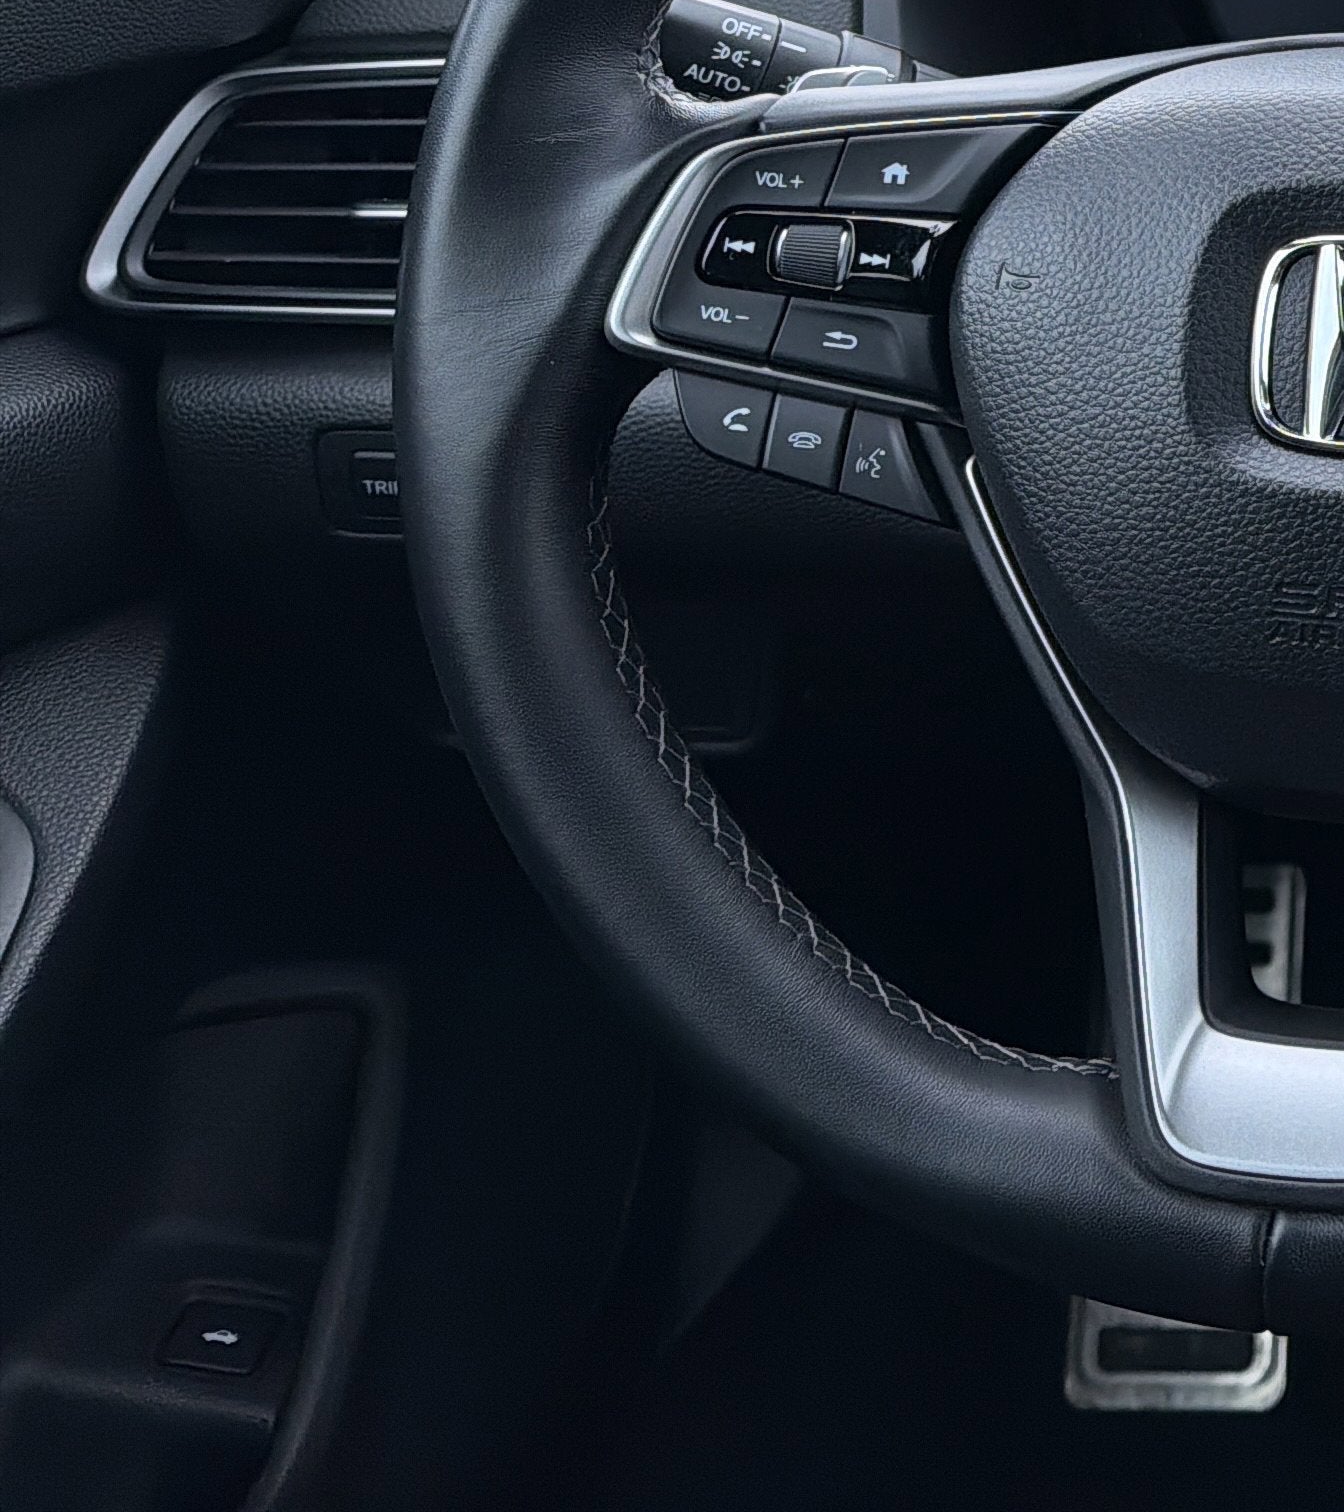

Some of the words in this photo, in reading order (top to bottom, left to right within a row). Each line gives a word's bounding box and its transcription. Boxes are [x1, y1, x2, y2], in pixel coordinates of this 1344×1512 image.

[721, 17, 763, 42] OFF
[683, 63, 742, 93] AUTO
[362, 479, 399, 496] TRI
